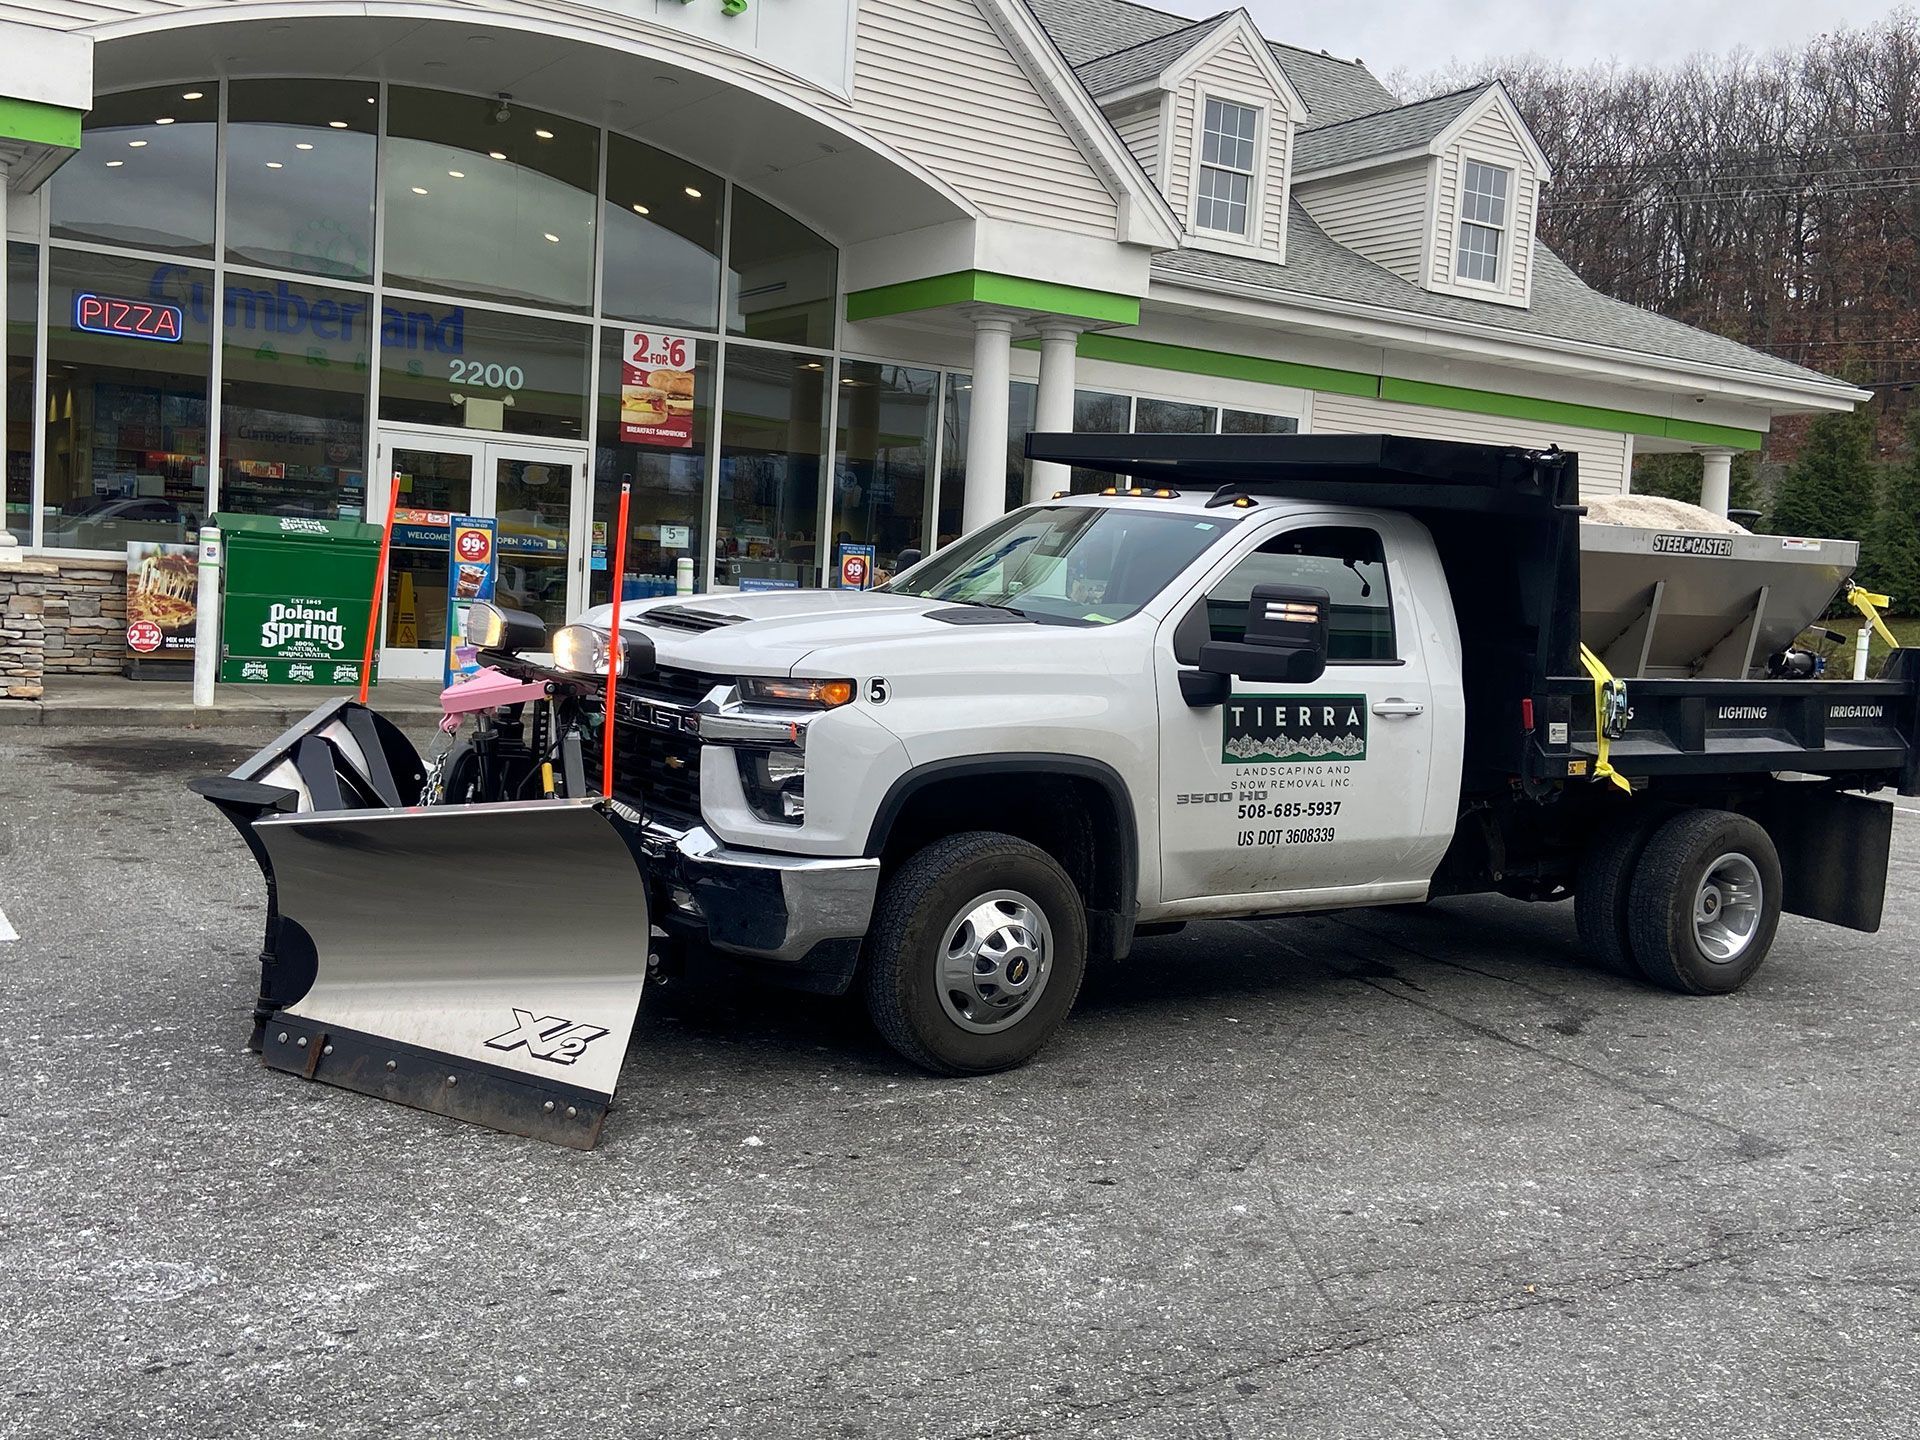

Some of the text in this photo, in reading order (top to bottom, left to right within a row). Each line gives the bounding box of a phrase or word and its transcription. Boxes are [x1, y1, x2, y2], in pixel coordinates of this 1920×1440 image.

[82, 299, 176, 336] PIZZA
[633, 334, 686, 367] 2 FOR $6
[449, 359, 524, 390] 2200
[626, 426, 687, 438] BREAKFAST SANDWICHES
[280, 521, 329, 533] Spring
[281, 517, 320, 527] Poland
[497, 537, 518, 545] OPEN
[1653, 535, 1733, 556] STEEL CASTER
[270, 603, 338, 623] Poland
[130, 630, 140, 644] 2
[145, 631, 159, 644] $2
[261, 620, 345, 650] Spring
[242, 667, 269, 678] Spring
[288, 669, 314, 680] Spring
[333, 670, 359, 680] Spring
[871, 679, 886, 703] 5
[1231, 706, 1360, 726] TIERRA
[1718, 706, 1768, 719] LIGHTING
[1830, 705, 1883, 718] IRRIGATION
[1235, 765, 1351, 777] LANDSCAPING AND
[1231, 780, 1267, 790] SNOW
[1270, 779, 1326, 788] REMOVAL
[1177, 790, 1268, 805] 3500 HD
[1237, 801, 1342, 819] 508-685-5937
[1237, 827, 1336, 846] US DOT 3608339
